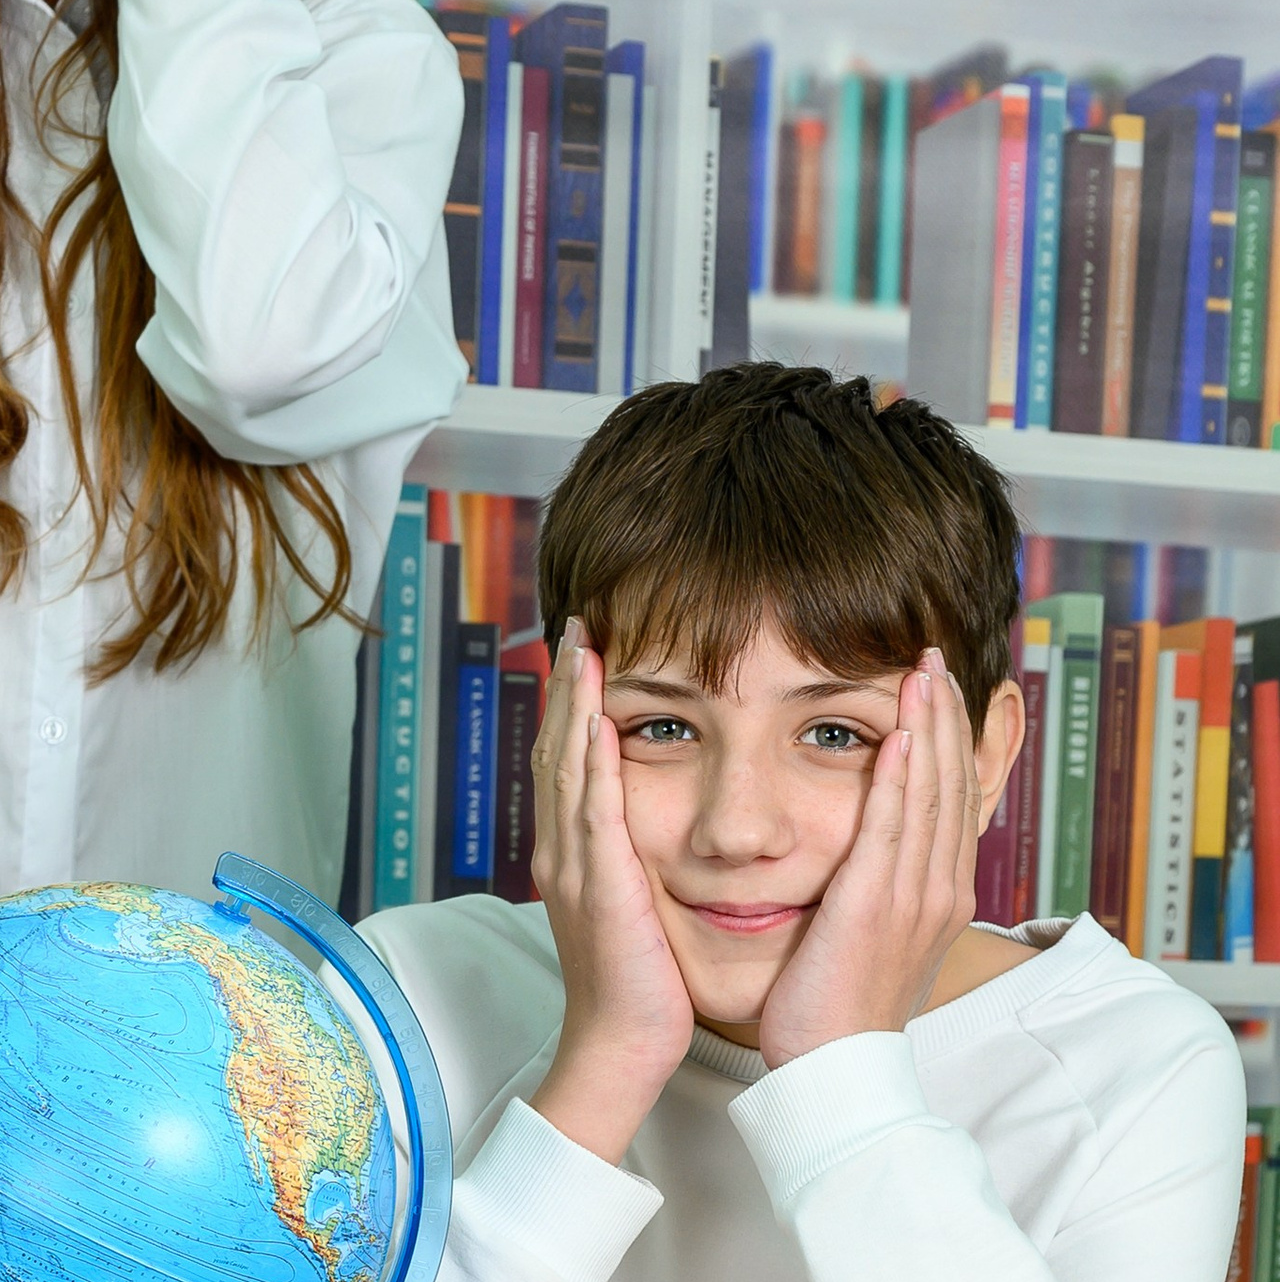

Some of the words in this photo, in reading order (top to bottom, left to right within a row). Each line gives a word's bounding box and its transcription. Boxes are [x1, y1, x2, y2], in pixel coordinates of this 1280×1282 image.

[1033, 132, 1059, 403] CONSTRUCTION
[392, 556, 416, 880] CONSTRUCTION
[467, 678, 484, 782] CLASSICAL
[1069, 677, 1090, 779] HISTORY
[464, 789, 483, 866] POETRY
[507, 781, 522, 863] Algebra
[1164, 709, 1186, 946] STATISTICS
